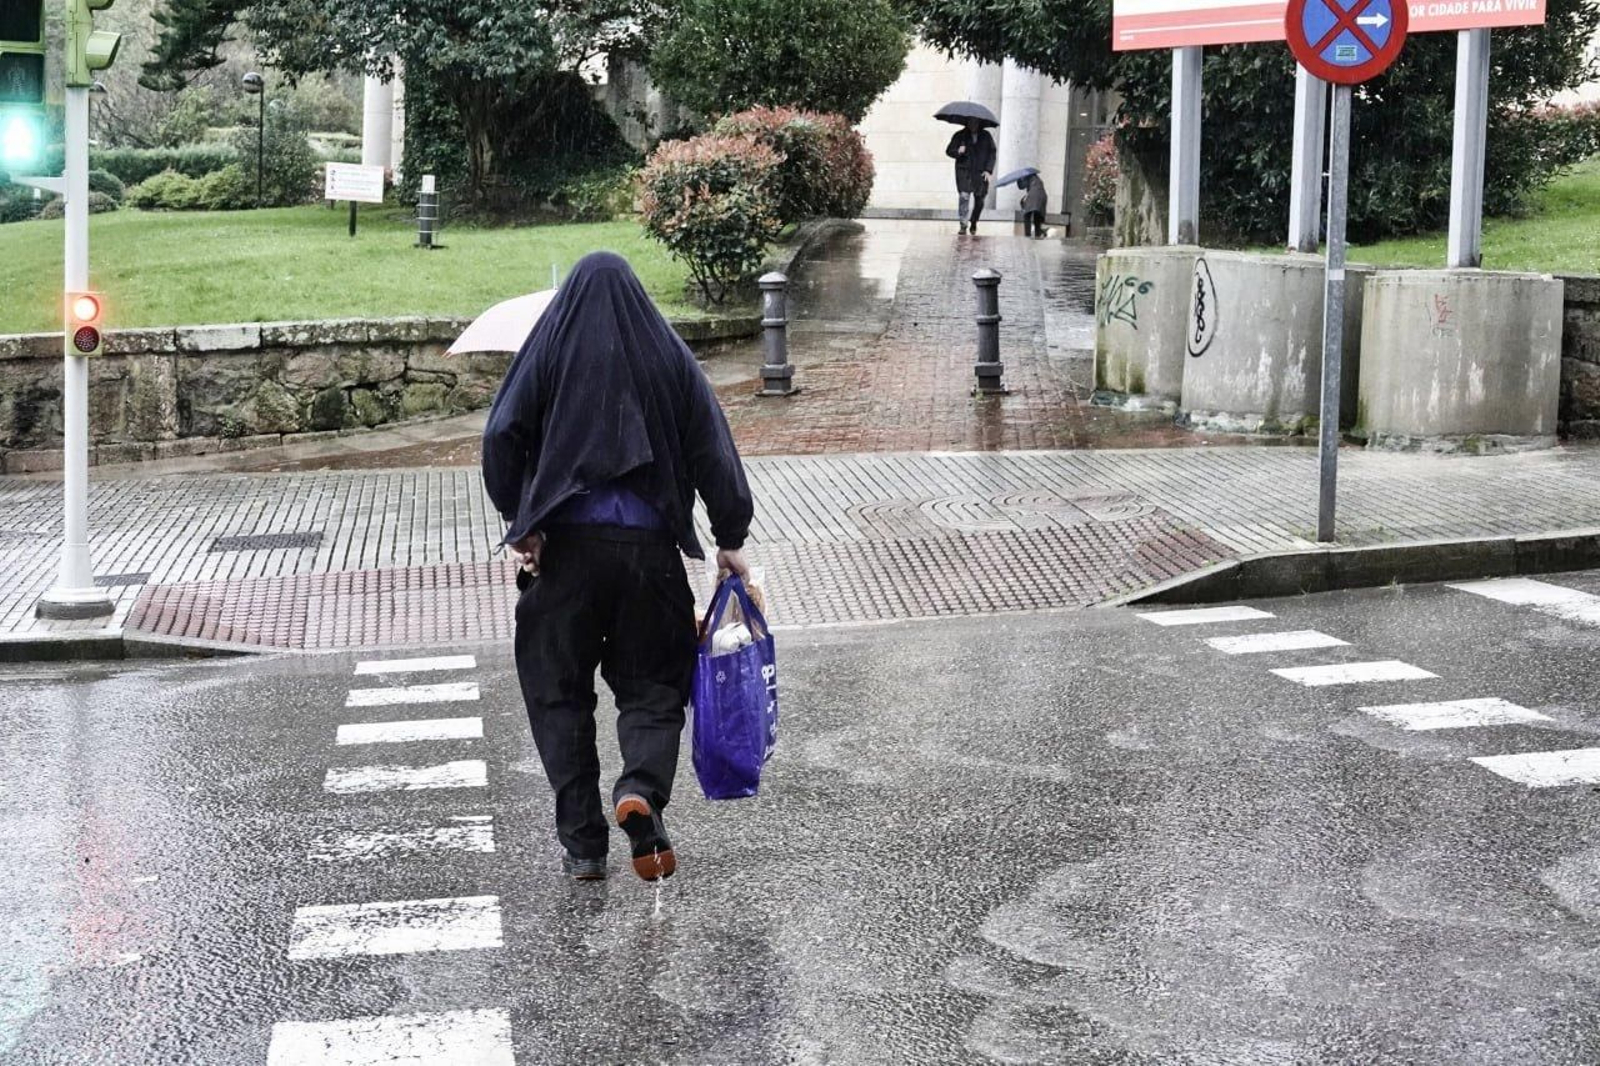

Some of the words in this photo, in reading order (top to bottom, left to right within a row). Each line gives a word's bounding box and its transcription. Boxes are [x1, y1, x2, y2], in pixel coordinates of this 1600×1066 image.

[1428, 3, 1469, 16] CIDADE
[1472, 2, 1501, 13] PARA
[1504, 0, 1537, 10] VIVIR
